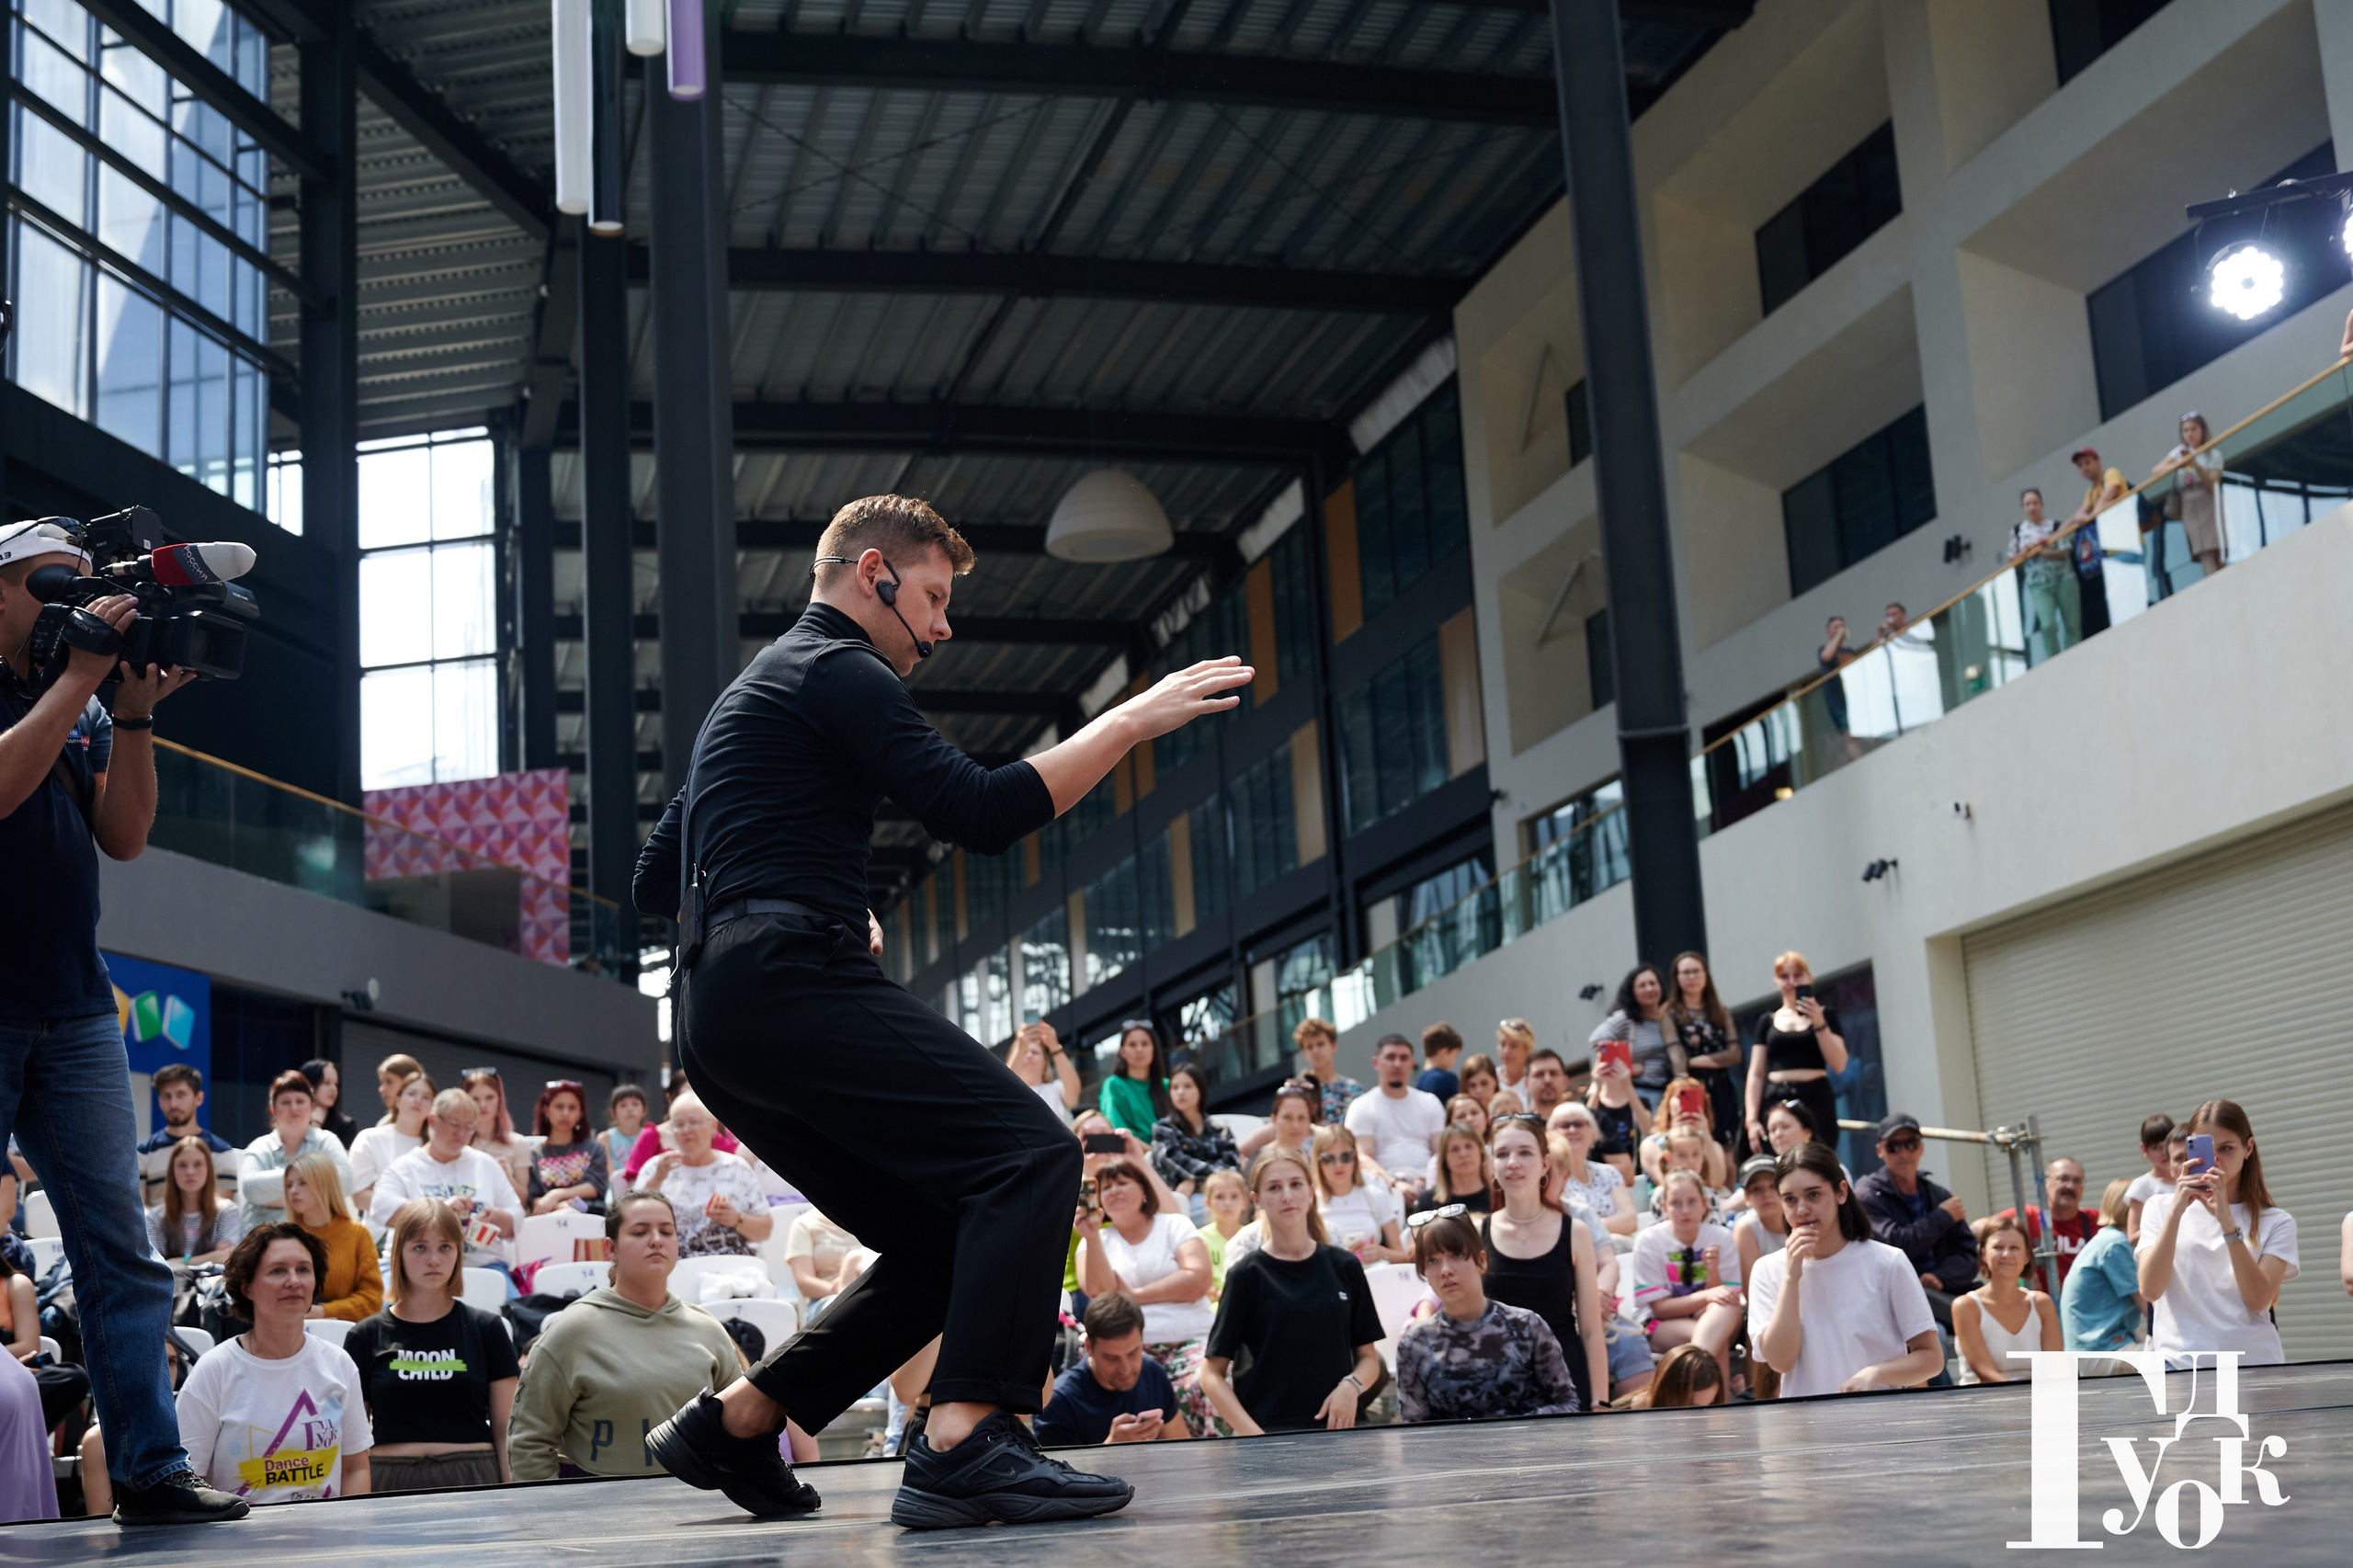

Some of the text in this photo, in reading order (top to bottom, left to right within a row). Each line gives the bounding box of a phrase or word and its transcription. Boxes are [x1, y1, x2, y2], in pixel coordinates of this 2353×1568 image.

[183, 545, 209, 581] РОССИЯ
[73, 619, 96, 634] SONY
[2054, 1234, 2086, 1255] ILA
[397, 1348, 456, 1363] MOON
[398, 1369, 454, 1381] CHILD
[264, 1457, 309, 1472] Dance
[265, 1462, 324, 1485] BATTLE
